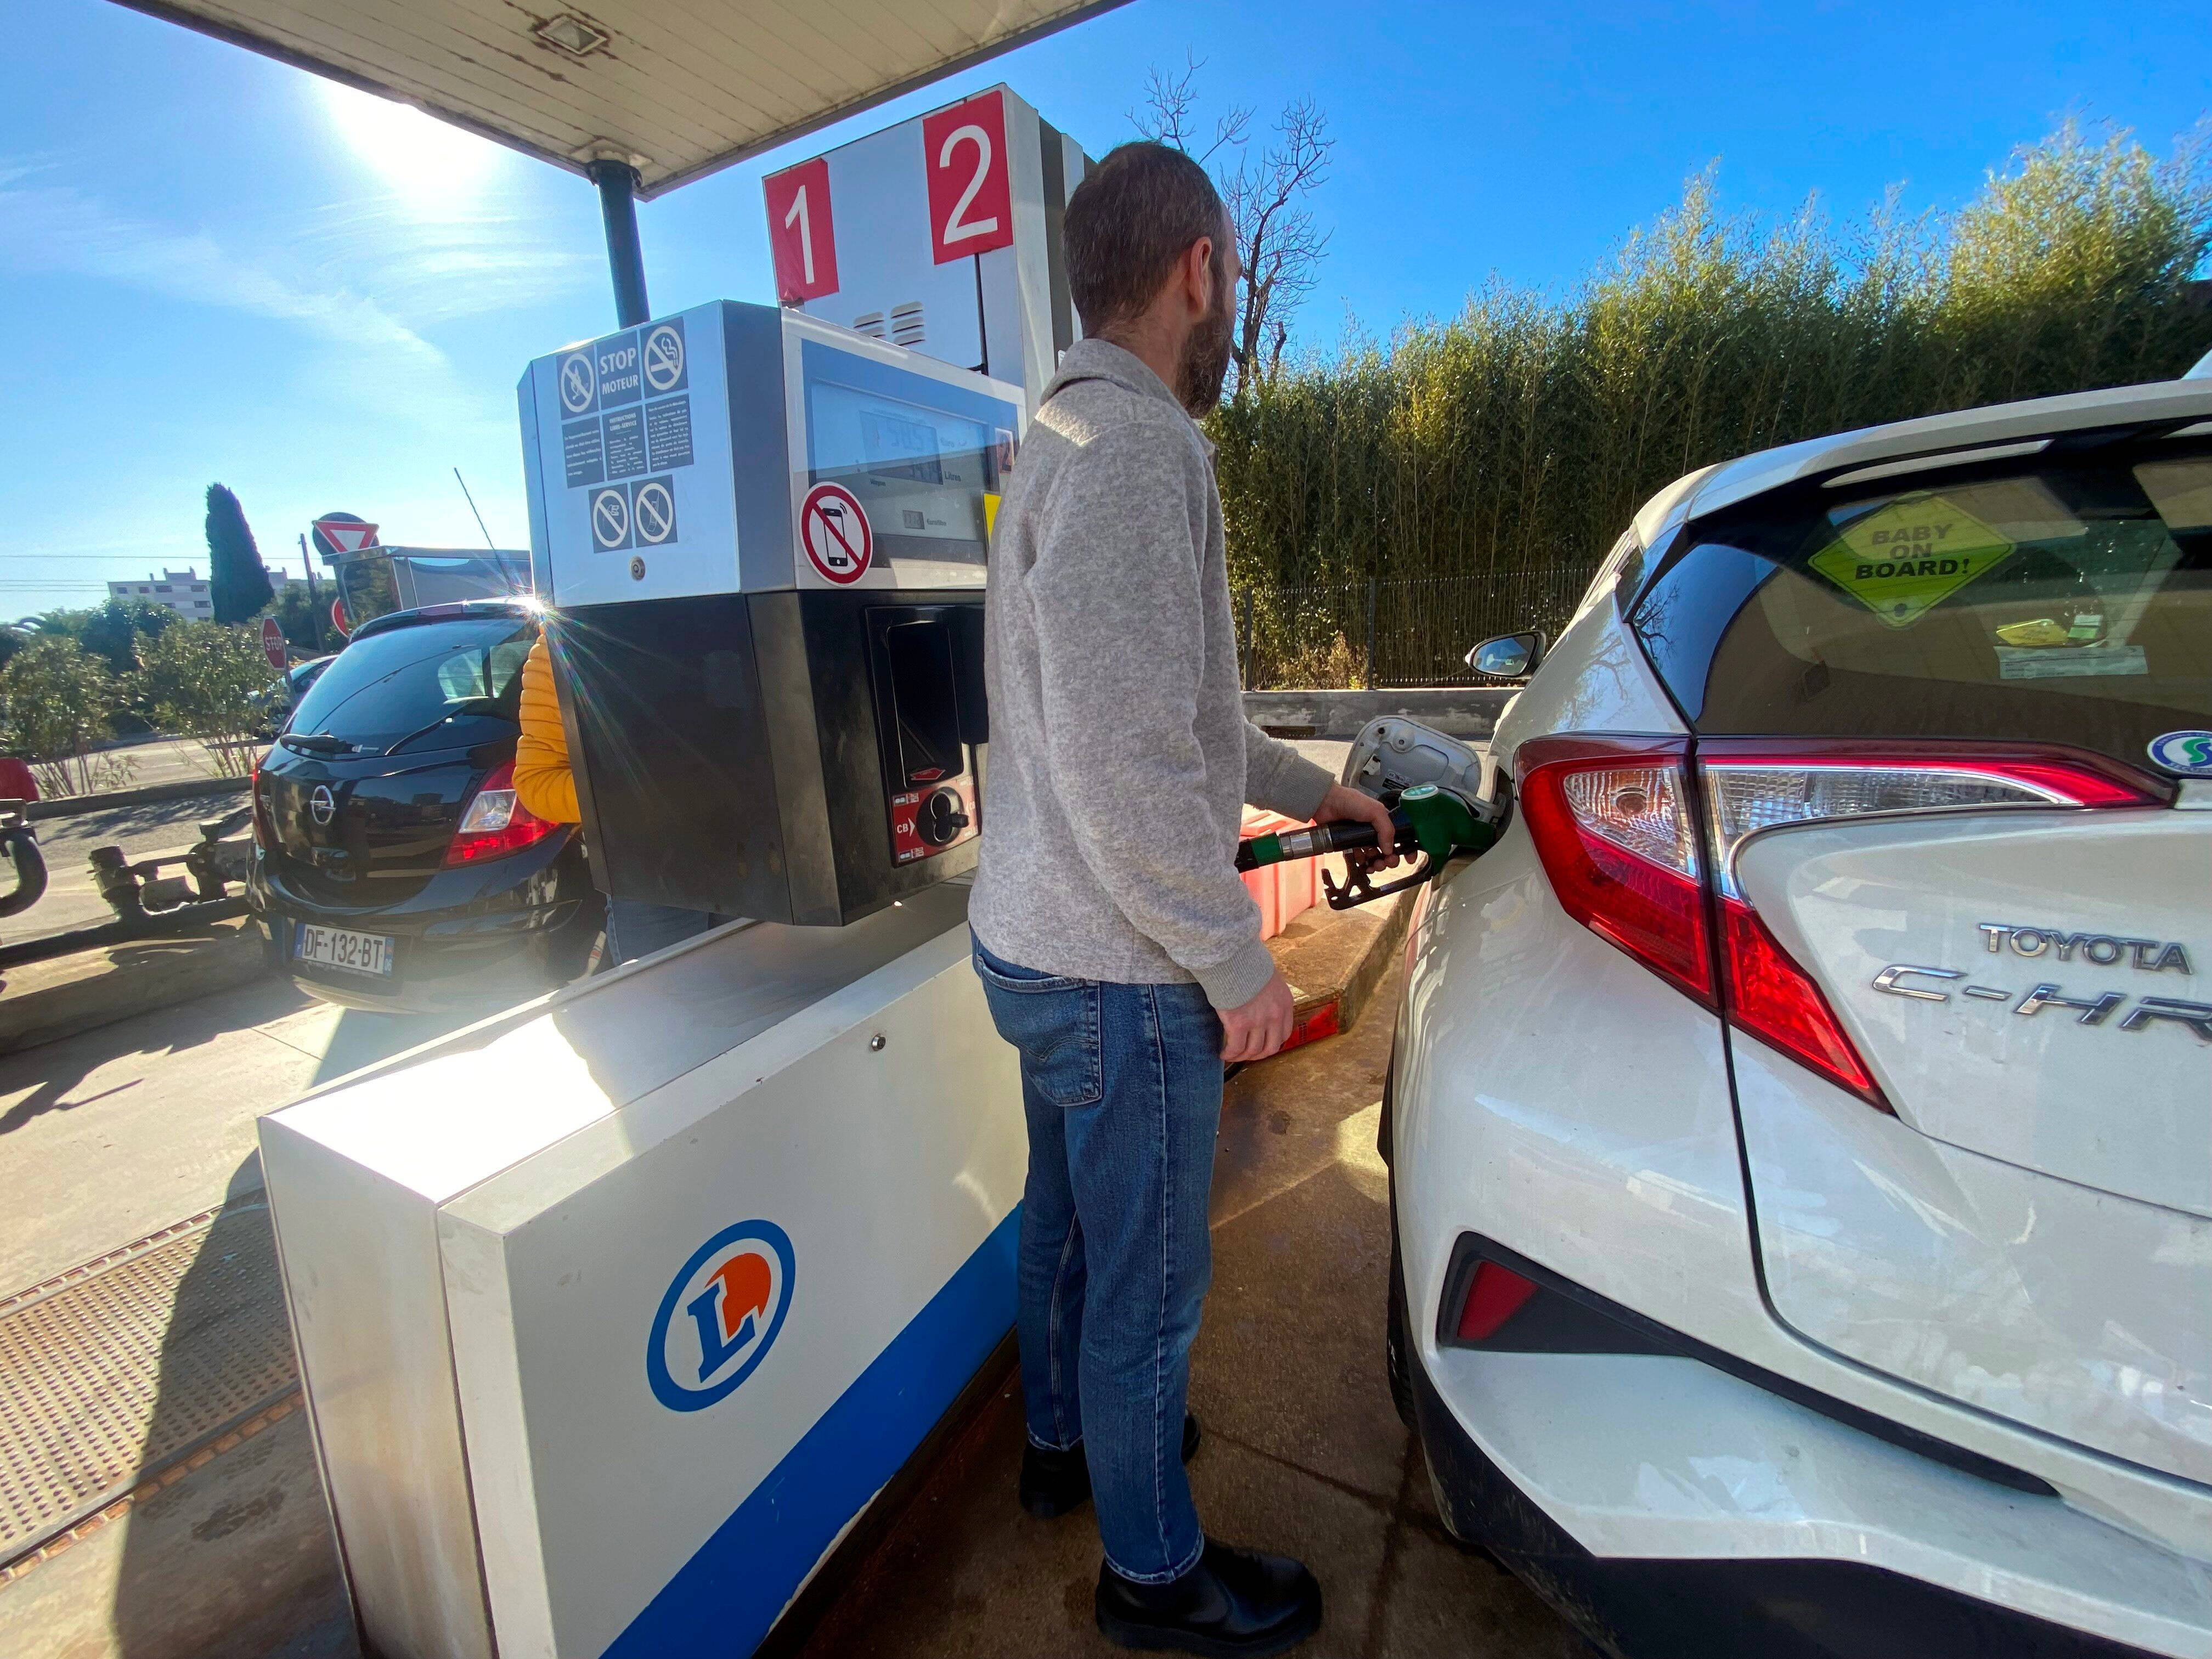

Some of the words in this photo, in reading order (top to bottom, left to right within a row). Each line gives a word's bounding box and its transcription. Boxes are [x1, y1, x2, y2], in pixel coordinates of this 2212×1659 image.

[939, 125, 998, 245] 2
[785, 185, 815, 284] 1
[600, 347, 636, 375] STOP
[602, 375, 639, 395] MOTEUR
[944, 471, 962, 482] Litres
[1871, 524, 1953, 545] BABY
[1889, 543, 1933, 560] ON
[1855, 557, 1970, 580] BOARD!
[265, 636, 283, 651] STOP
[896, 823, 909, 834] CB
[304, 928, 383, 969] DF-132-BT
[1978, 922, 2194, 975] TOYOTA
[1871, 963, 2212, 1041] C-HR
